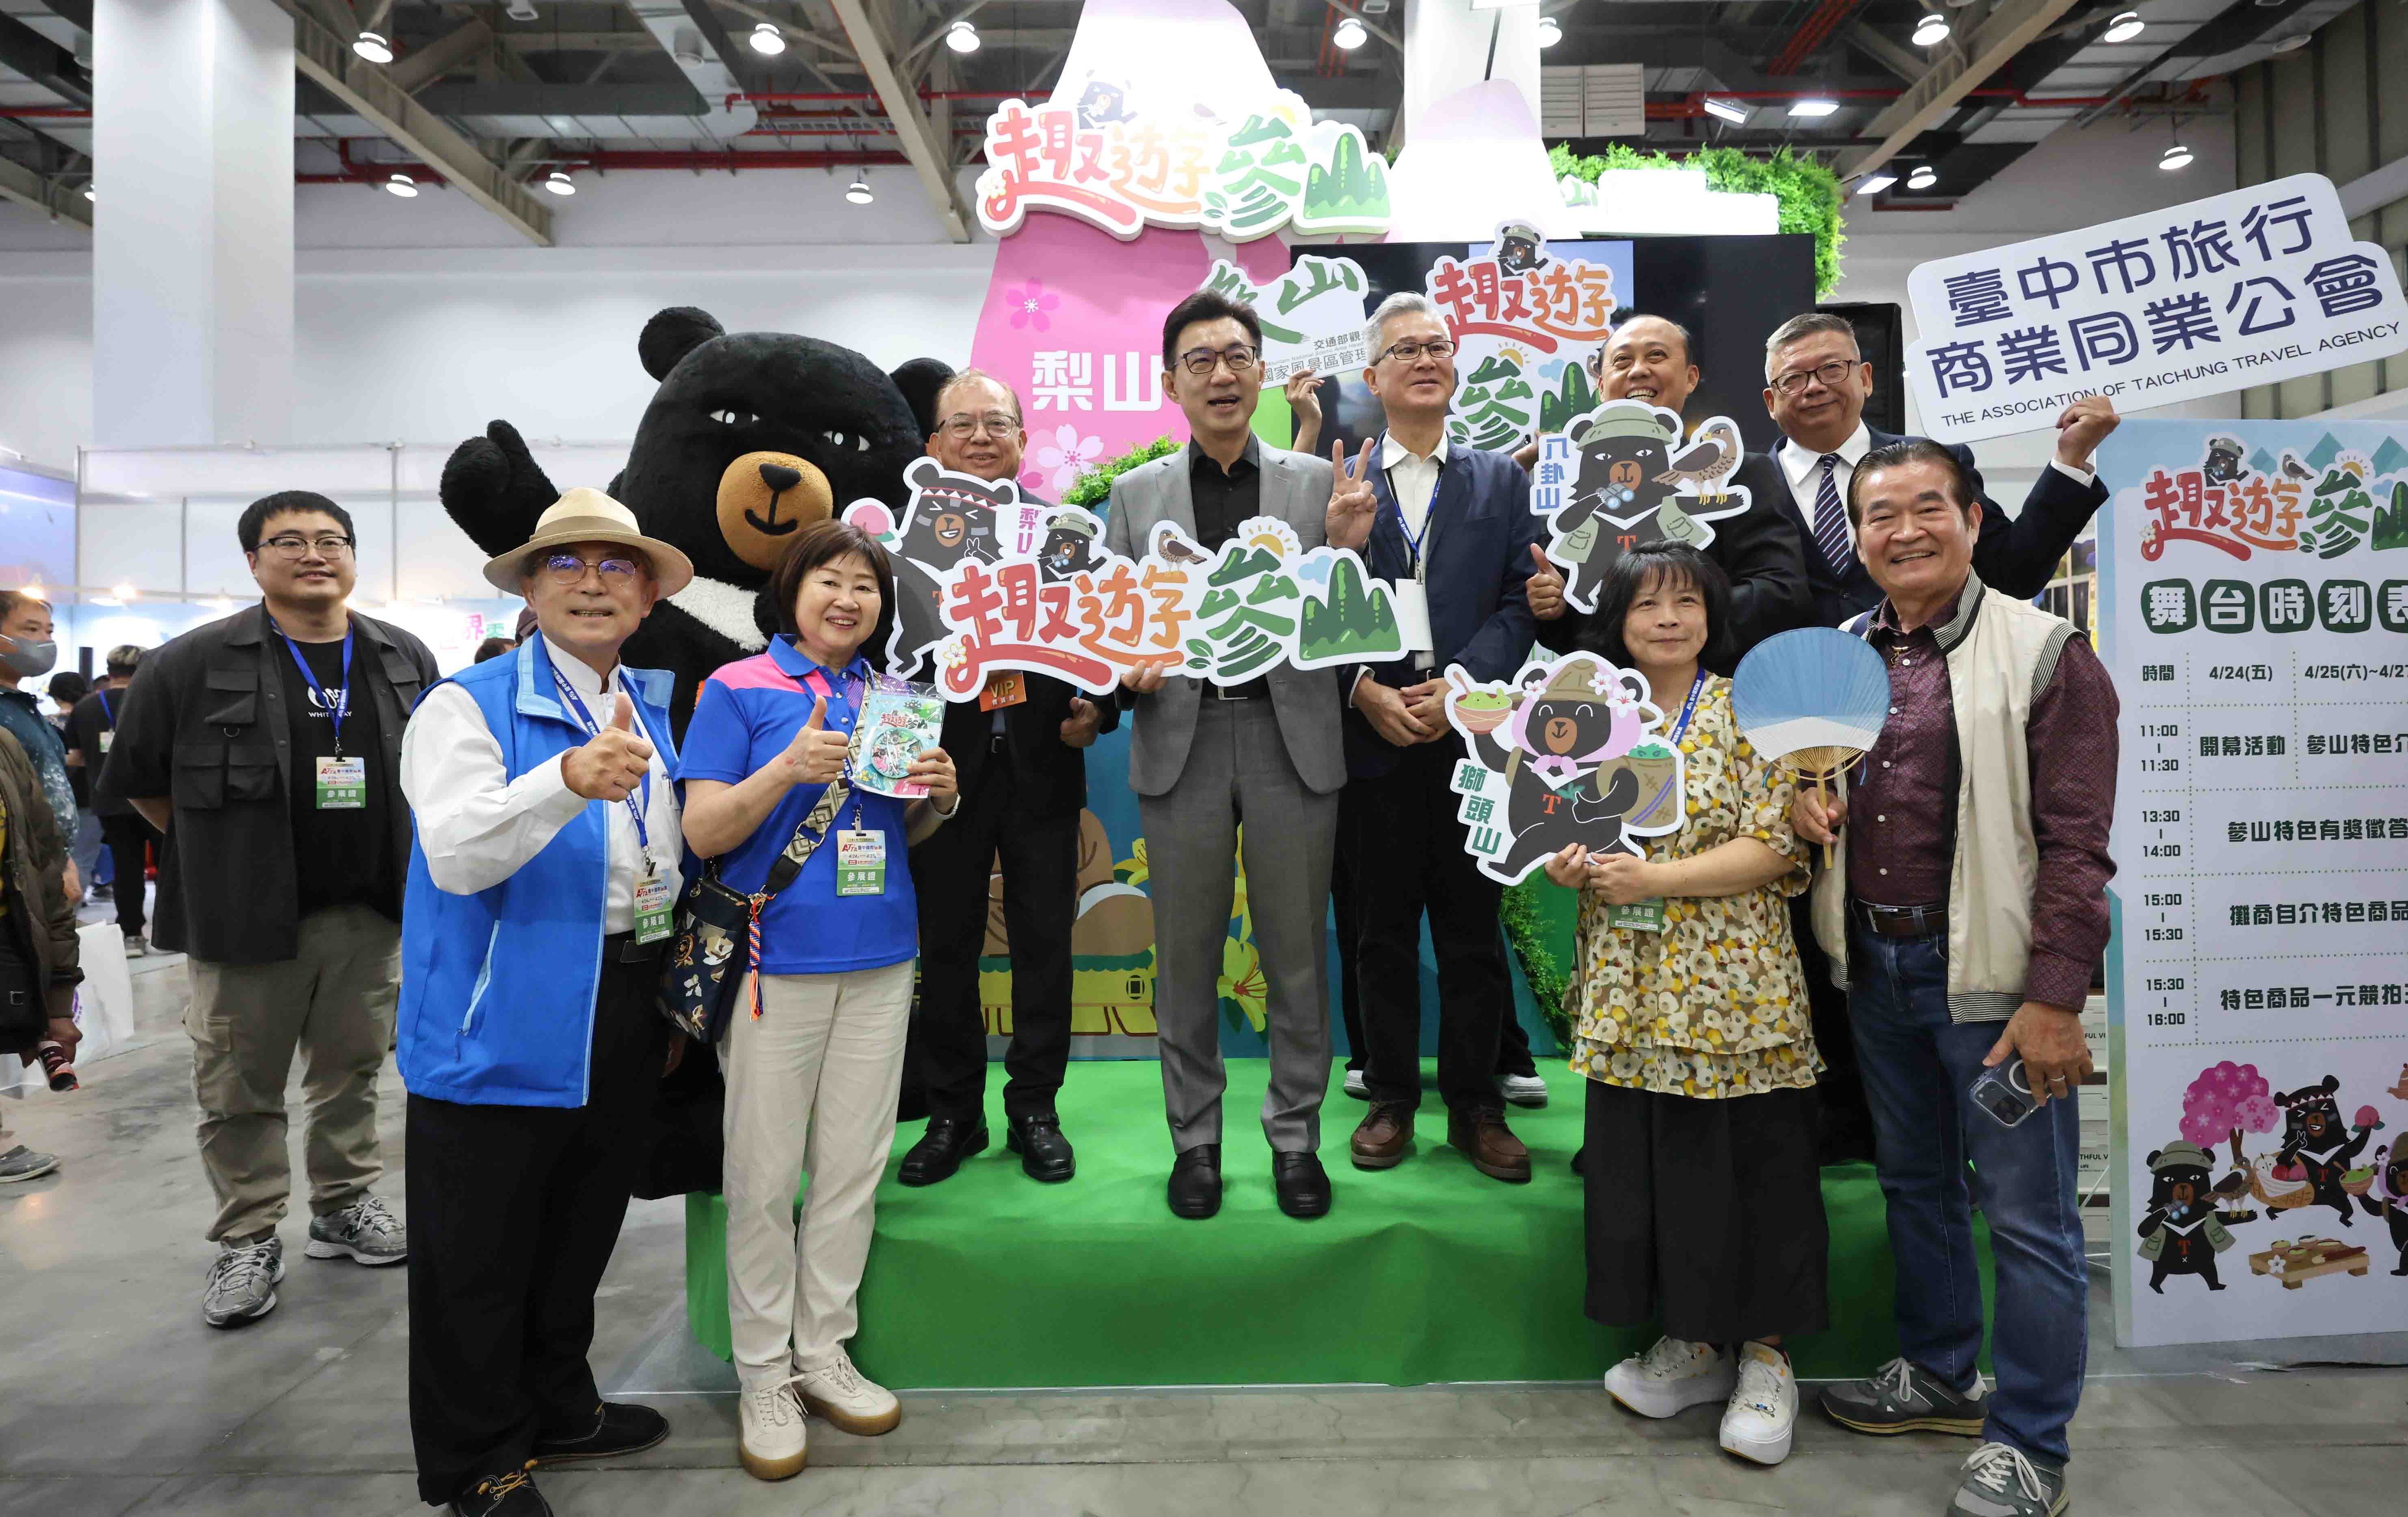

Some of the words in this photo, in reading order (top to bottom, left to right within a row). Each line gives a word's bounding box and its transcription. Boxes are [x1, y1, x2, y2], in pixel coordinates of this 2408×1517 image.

[1943, 195, 2313, 327] 臺中市旅行
[1925, 253, 2384, 399] 商業同業公會
[1313, 330, 1365, 350] 交通部觀
[1032, 350, 1164, 412] 梨山
[1941, 411, 1976, 427] THE
[1981, 388, 2097, 421] ASSOCIATION
[2103, 382, 2126, 397] OF
[2131, 361, 2228, 391] TAICHUNG
[2232, 344, 2311, 369] TRAVEL
[2319, 322, 2400, 352] AGENCY
[1536, 437, 1569, 510] 八卦山
[2149, 585, 2408, 626] 舞台時刻表
[2142, 665, 2175, 681] 時間
[2209, 665, 2273, 682] 4/24(五)
[990, 680, 1014, 698] VIP
[2141, 725, 2178, 737] 11:00
[2200, 735, 2285, 757] 開幕活動
[2142, 760, 2179, 772] 11:30
[1458, 763, 1502, 855] 獅頭山
[2142, 810, 2180, 823] 13:30
[2228, 818, 2408, 843] 參山特色有獎徵答
[2143, 845, 2181, 857] 14:00
[847, 872, 876, 882] 參展證
[2144, 893, 2182, 906] 15:00
[1621, 906, 1654, 918] 參展證
[2229, 900, 2408, 926] 攤商自介特色商品
[2145, 928, 2183, 941] 15:30
[2146, 978, 2185, 991] 15:30
[2220, 984, 2408, 1010] 特色商品一元競拍
[2147, 1013, 2185, 1026] 16:00
